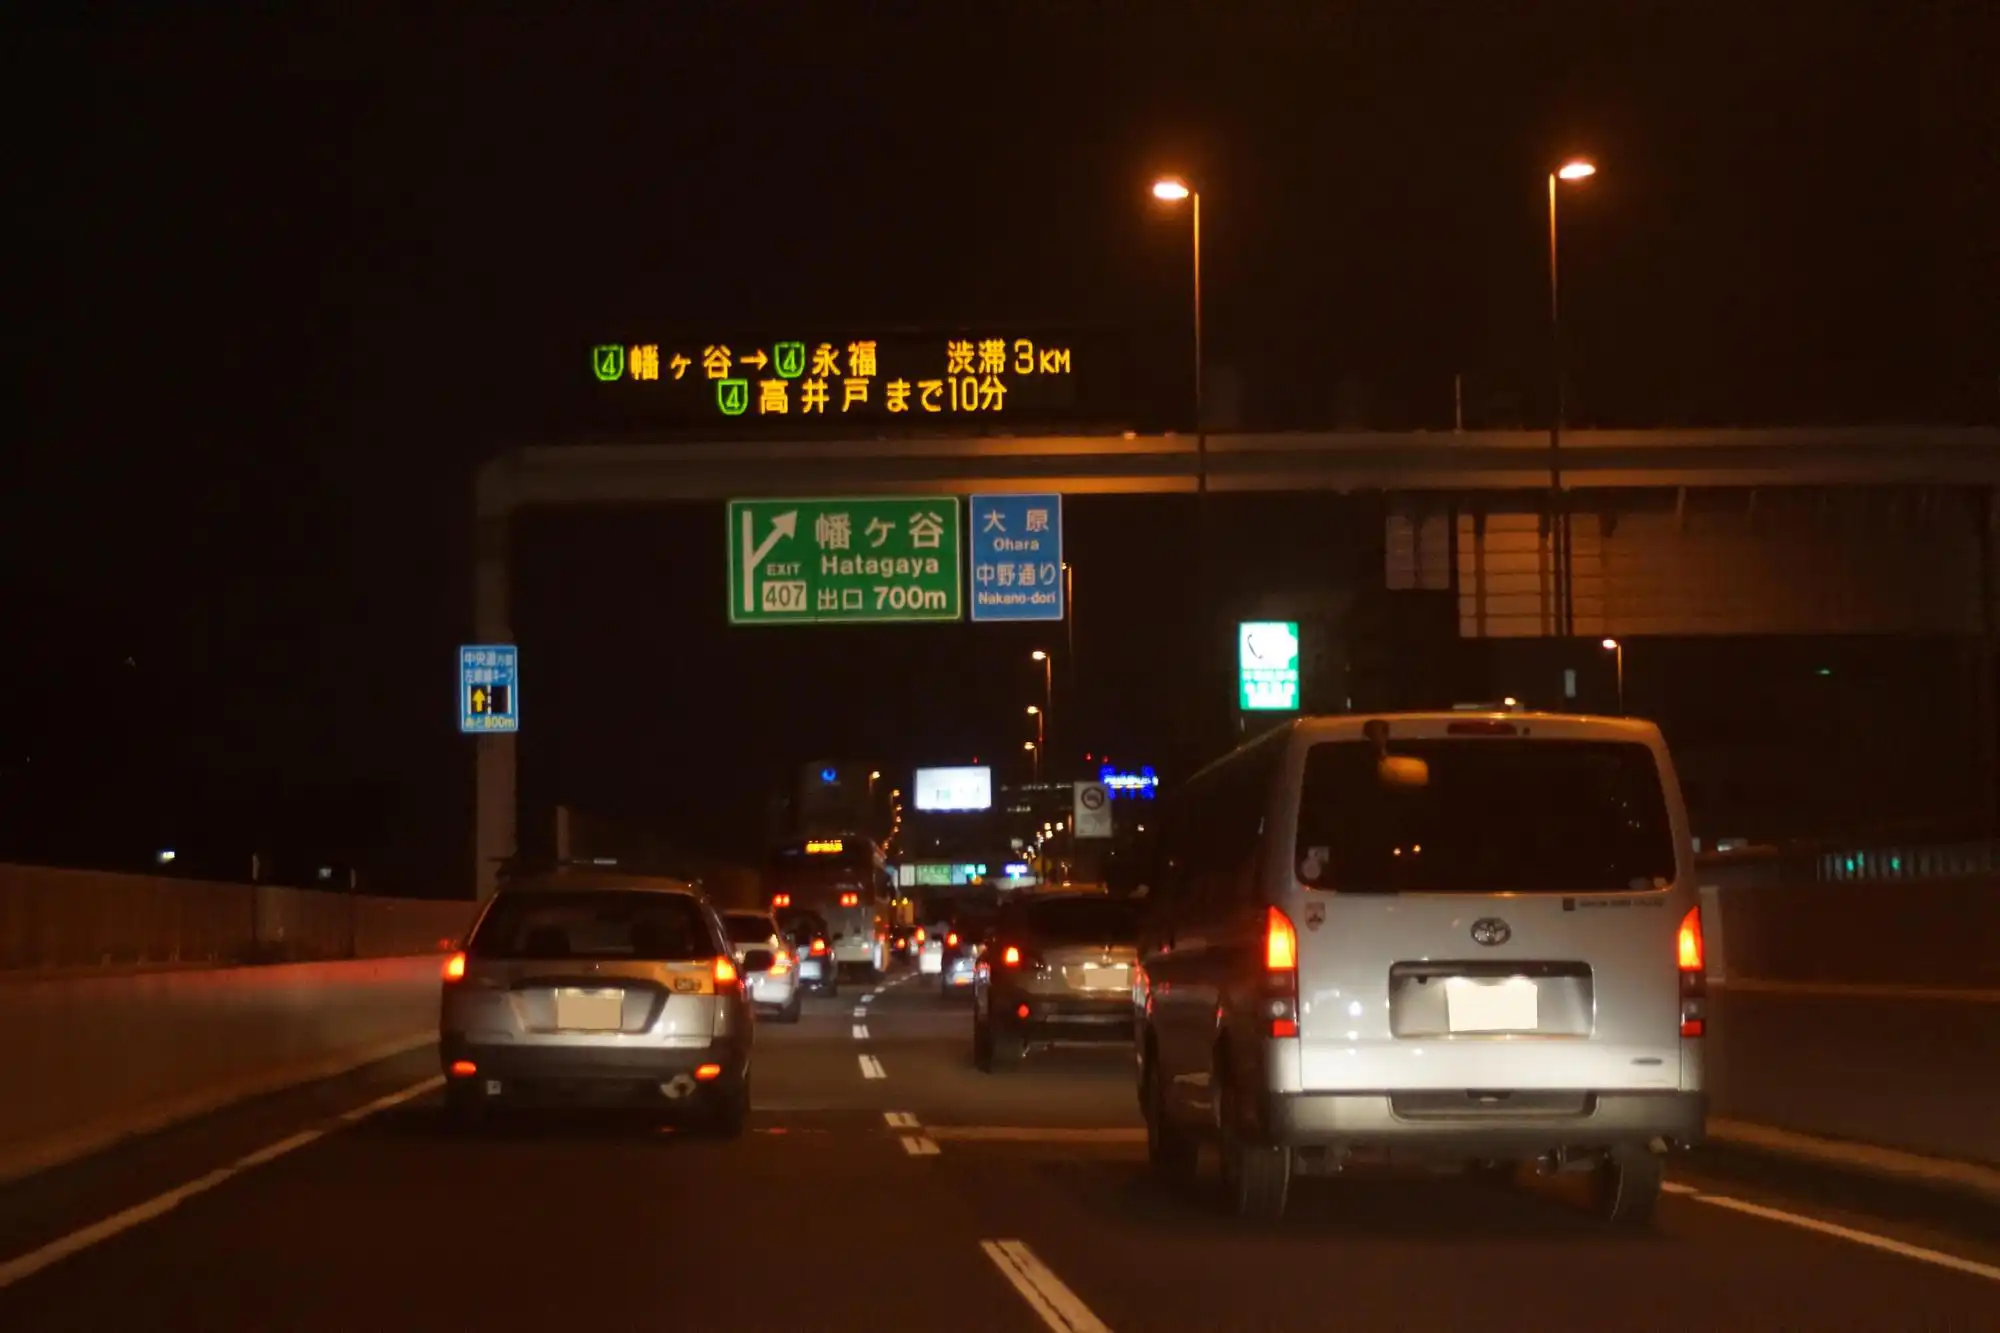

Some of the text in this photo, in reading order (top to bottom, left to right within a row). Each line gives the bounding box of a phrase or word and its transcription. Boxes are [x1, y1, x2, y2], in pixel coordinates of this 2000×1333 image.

[812, 342, 876, 377] 永福
[983, 509, 1049, 532] 大原
[994, 538, 1039, 551] Ohara
[767, 563, 801, 576] EXIT
[821, 553, 939, 578] Hatagaya
[976, 563, 1056, 586] 中野通り
[765, 584, 804, 607] 407
[817, 586, 946, 610] 出口 700m
[978, 591, 1056, 604] Nakano-dori
